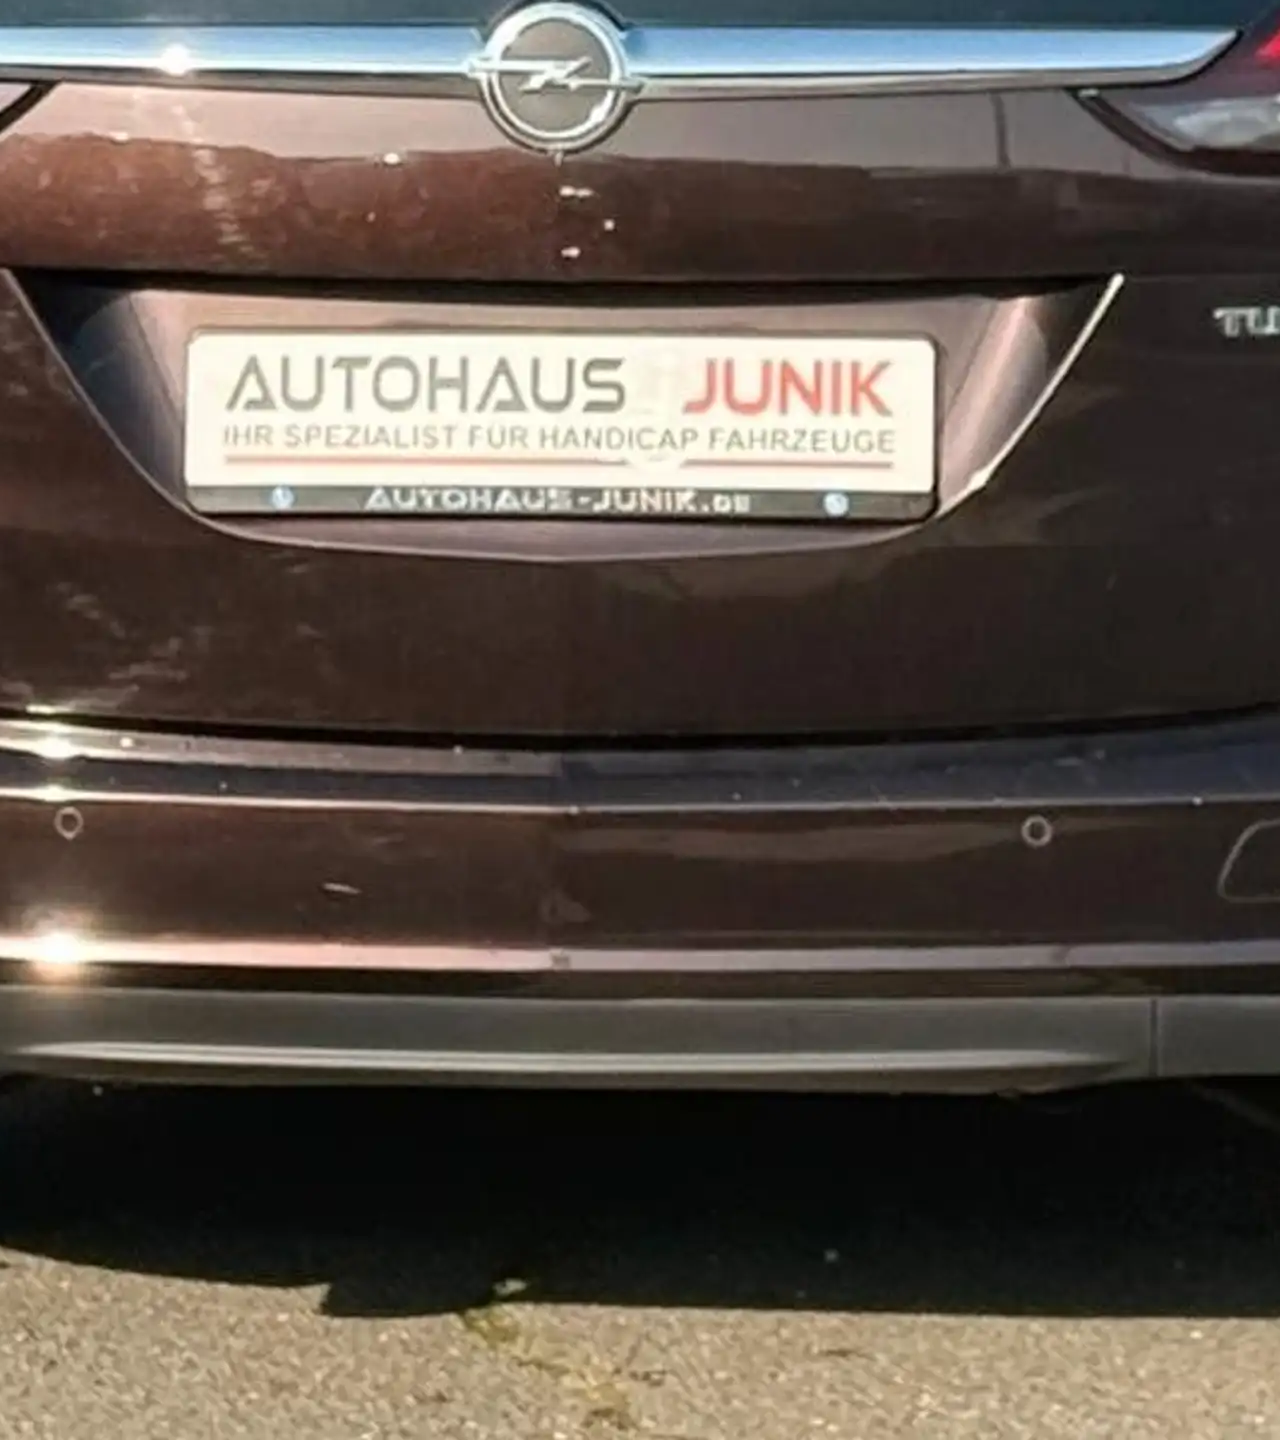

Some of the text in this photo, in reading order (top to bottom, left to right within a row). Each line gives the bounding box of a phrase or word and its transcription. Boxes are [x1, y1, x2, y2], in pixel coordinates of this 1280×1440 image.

[225, 356, 893, 417] AUTOHAUS JUNIK
[224, 423, 274, 448] IHR
[283, 424, 457, 450] SPEZIALIST
[539, 426, 699, 452] HANDICAP
[709, 428, 896, 455] FAHRZEUGE
